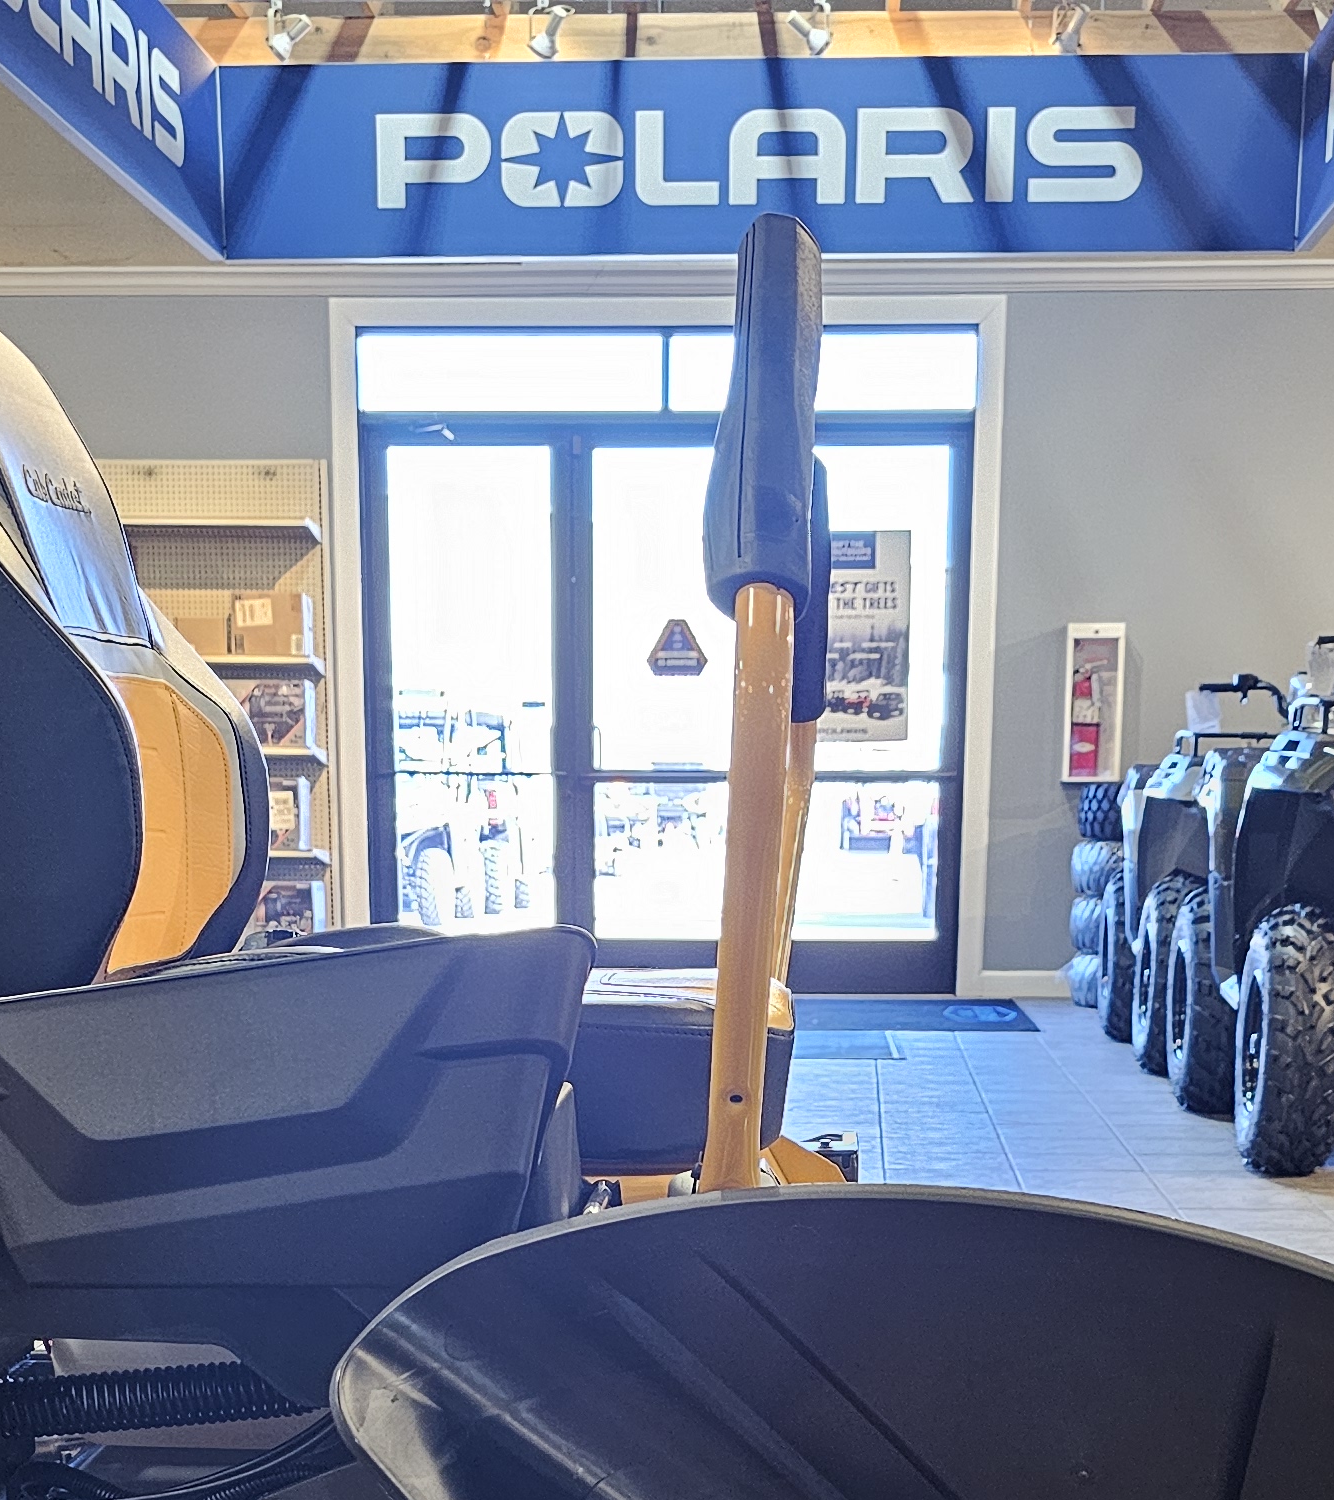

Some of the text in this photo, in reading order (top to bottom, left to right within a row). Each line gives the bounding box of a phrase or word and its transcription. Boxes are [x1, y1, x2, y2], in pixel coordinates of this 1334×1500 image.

[3, 0, 185, 168] LARIS
[374, 105, 1144, 210] POLARIS
[835, 597, 898, 611] THE TREES
[864, 581, 897, 595] GIFTS
